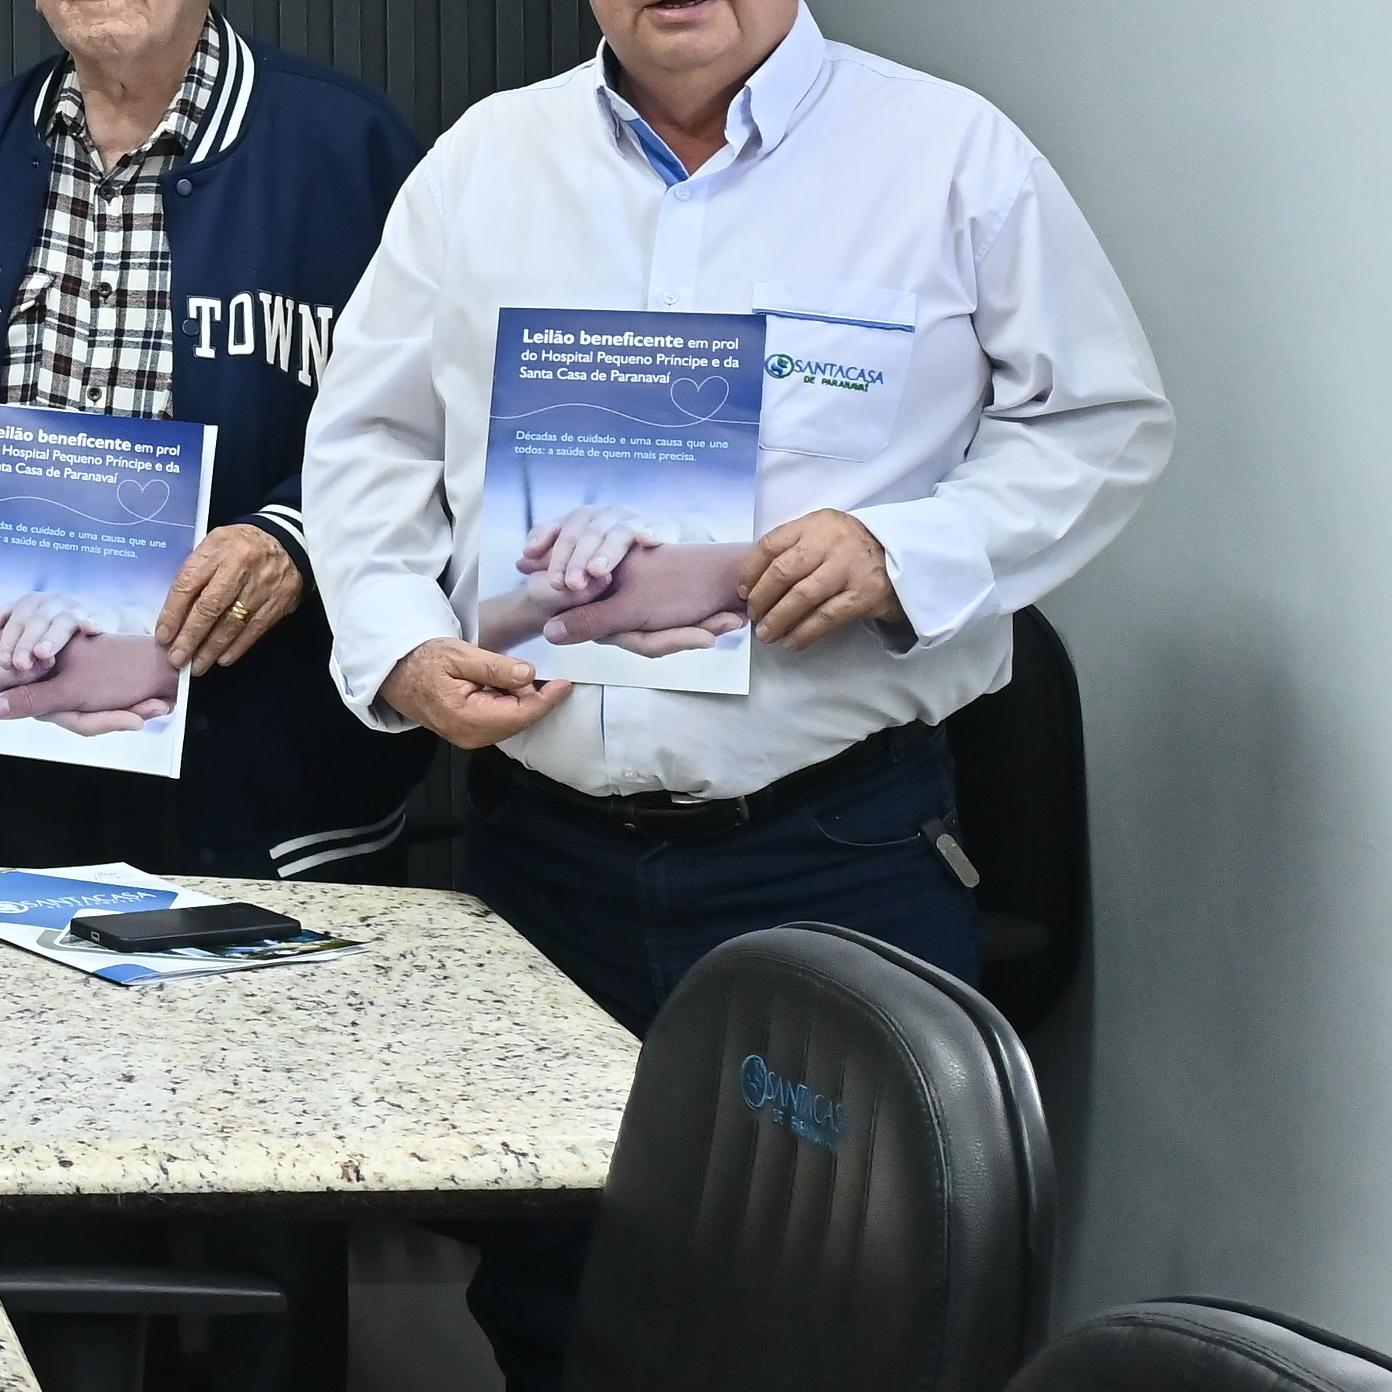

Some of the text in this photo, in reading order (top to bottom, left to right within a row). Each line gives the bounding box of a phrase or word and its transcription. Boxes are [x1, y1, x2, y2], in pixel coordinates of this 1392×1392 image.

[188, 292, 333, 387] TOWN
[523, 329, 739, 352] Leilão beneficente em prol
[521, 349, 739, 369] do Hospital Pequeno Príncipe e da
[520, 366, 670, 383] Santa Casa de Paranavaí
[804, 375, 816, 384] DE
[38, 429, 131, 451] beneficente
[134, 444, 153, 453] em
[156, 445, 180, 457] prol
[2, 444, 49, 460] Hospital
[53, 450, 102, 465] Pequeno
[106, 455, 152, 472] Príncipe
[155, 463, 163, 471] e
[165, 461, 180, 473] da
[15, 462, 43, 476] Casa
[46, 466, 61, 477] de
[64, 467, 118, 483] Paranavaí
